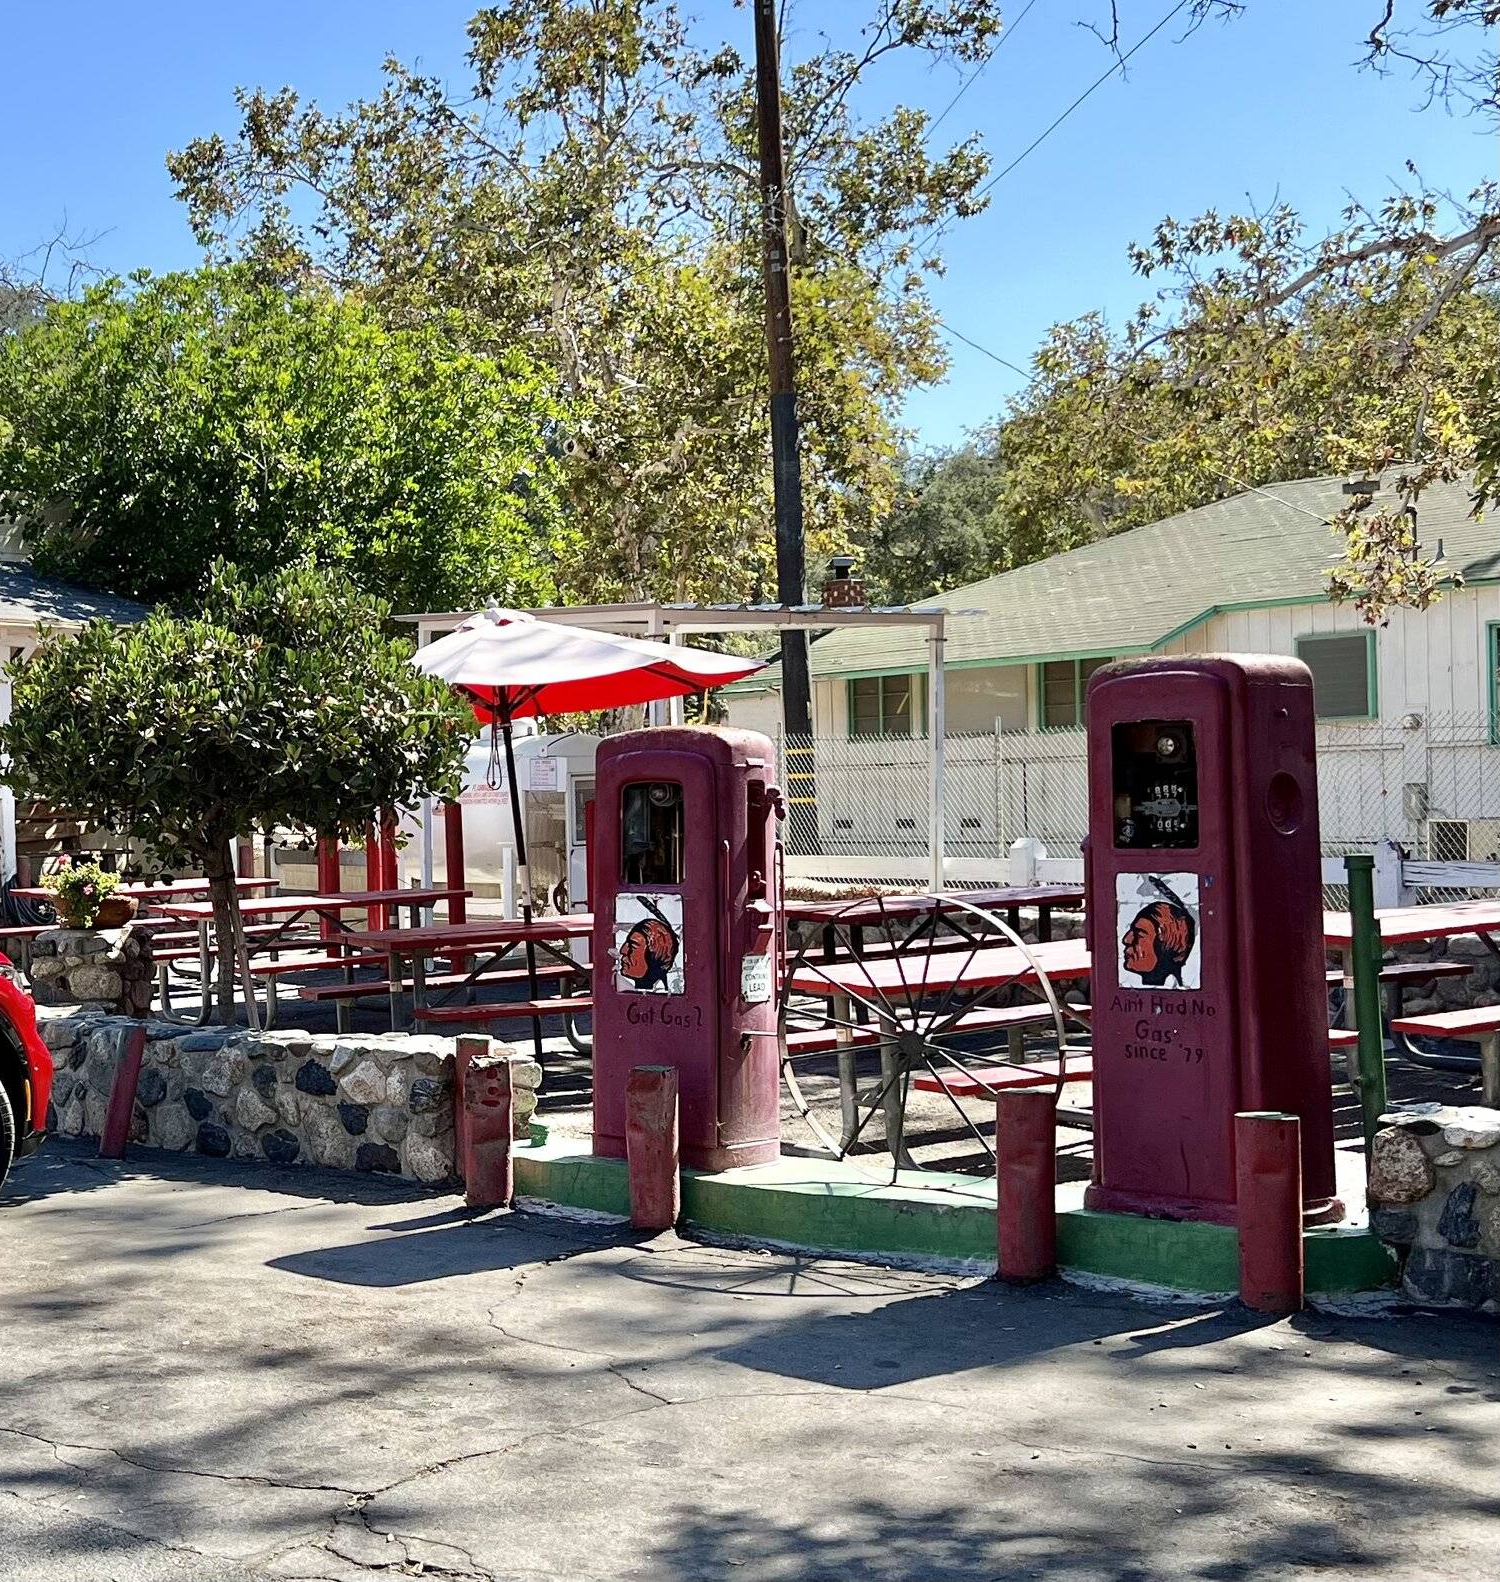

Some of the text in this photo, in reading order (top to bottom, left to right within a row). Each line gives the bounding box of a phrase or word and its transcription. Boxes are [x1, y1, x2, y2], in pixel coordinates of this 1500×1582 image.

[749, 983, 766, 992] LEAD
[626, 1001, 655, 1026] Got
[1150, 995, 1187, 1016] Had
[1192, 1000, 1216, 1017] No
[1134, 1019, 1172, 1044] Gas
